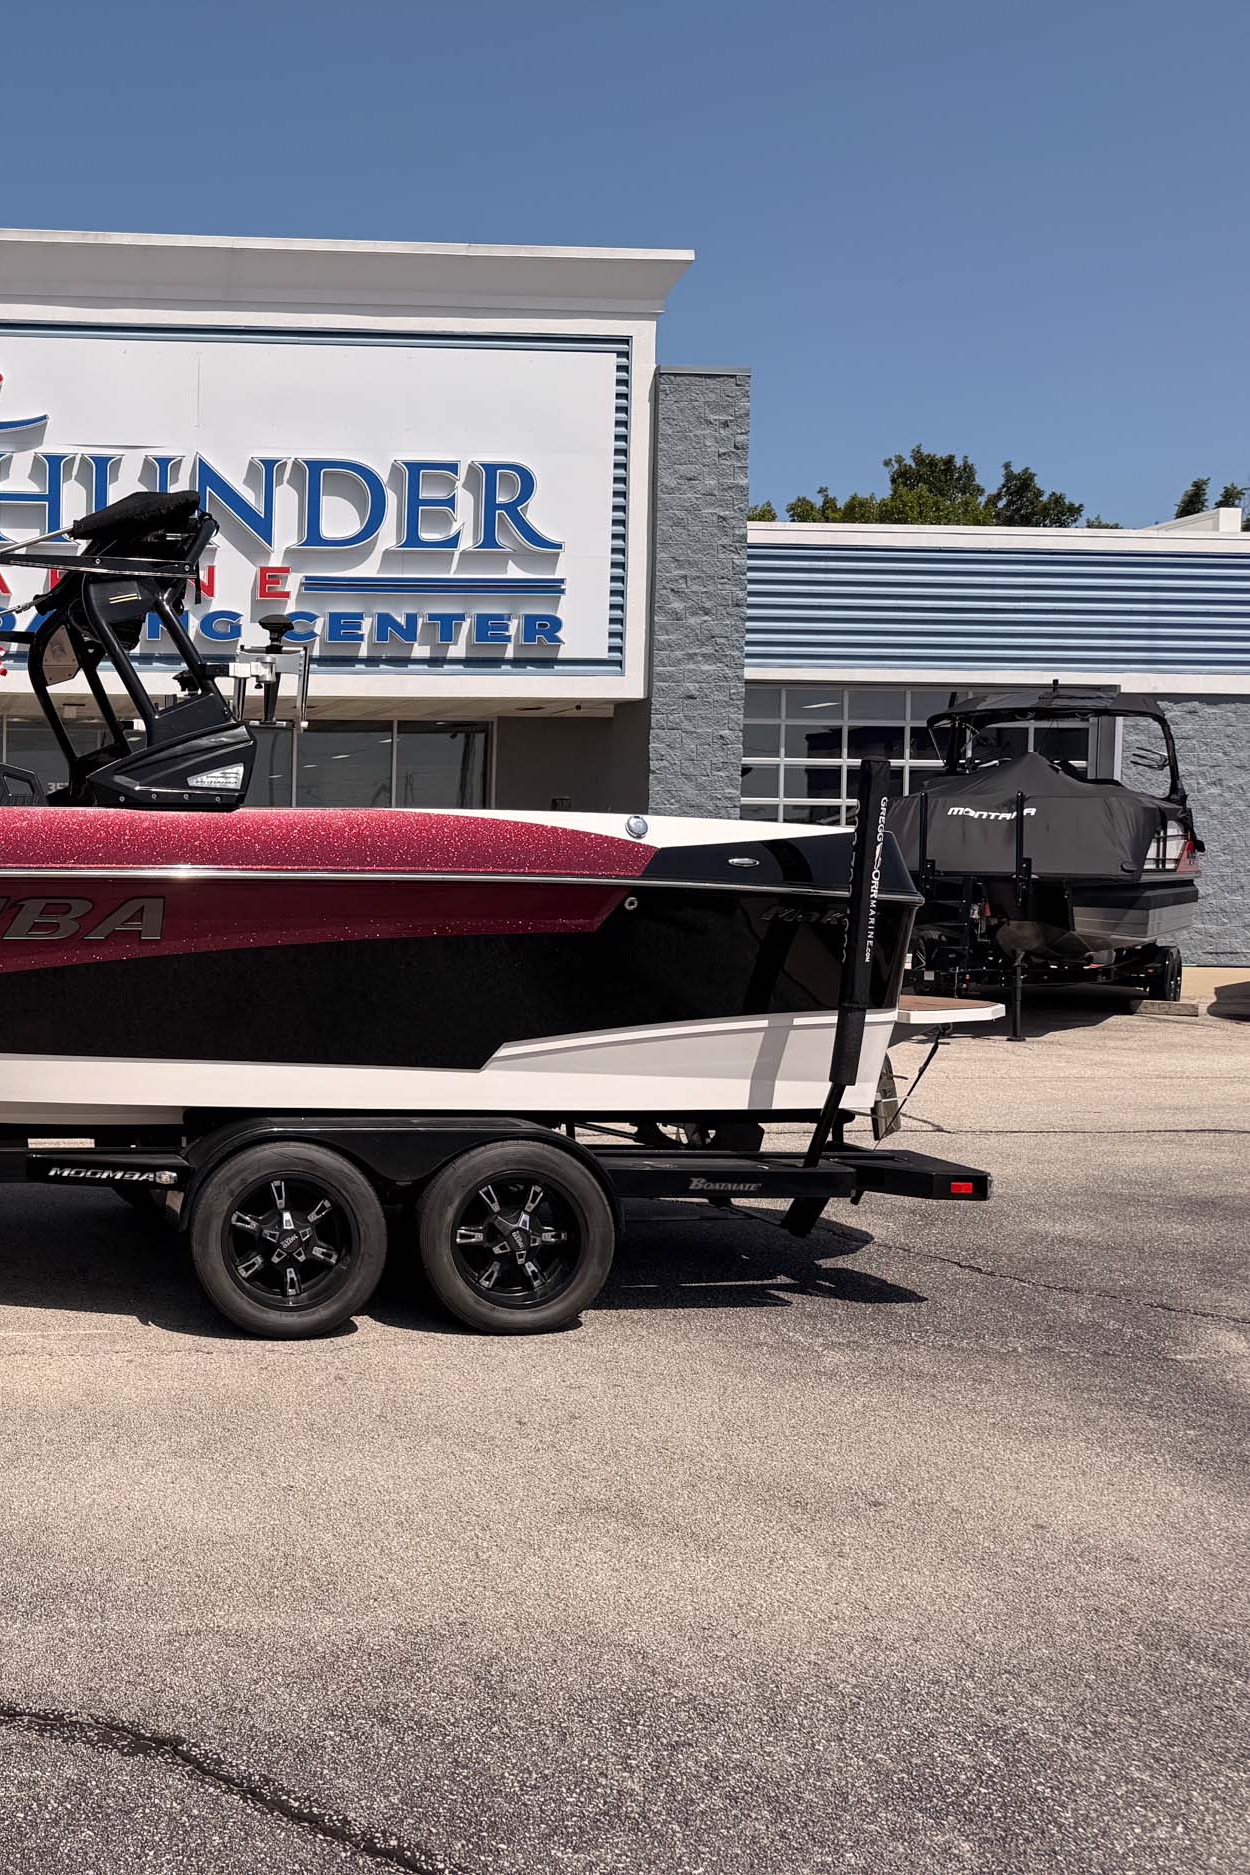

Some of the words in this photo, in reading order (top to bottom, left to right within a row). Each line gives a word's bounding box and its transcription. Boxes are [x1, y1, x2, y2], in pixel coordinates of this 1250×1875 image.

[283, 611, 565, 646] CENTER
[876, 796, 889, 842] GREGG
[48, 1167, 155, 1182] MOOMBA
